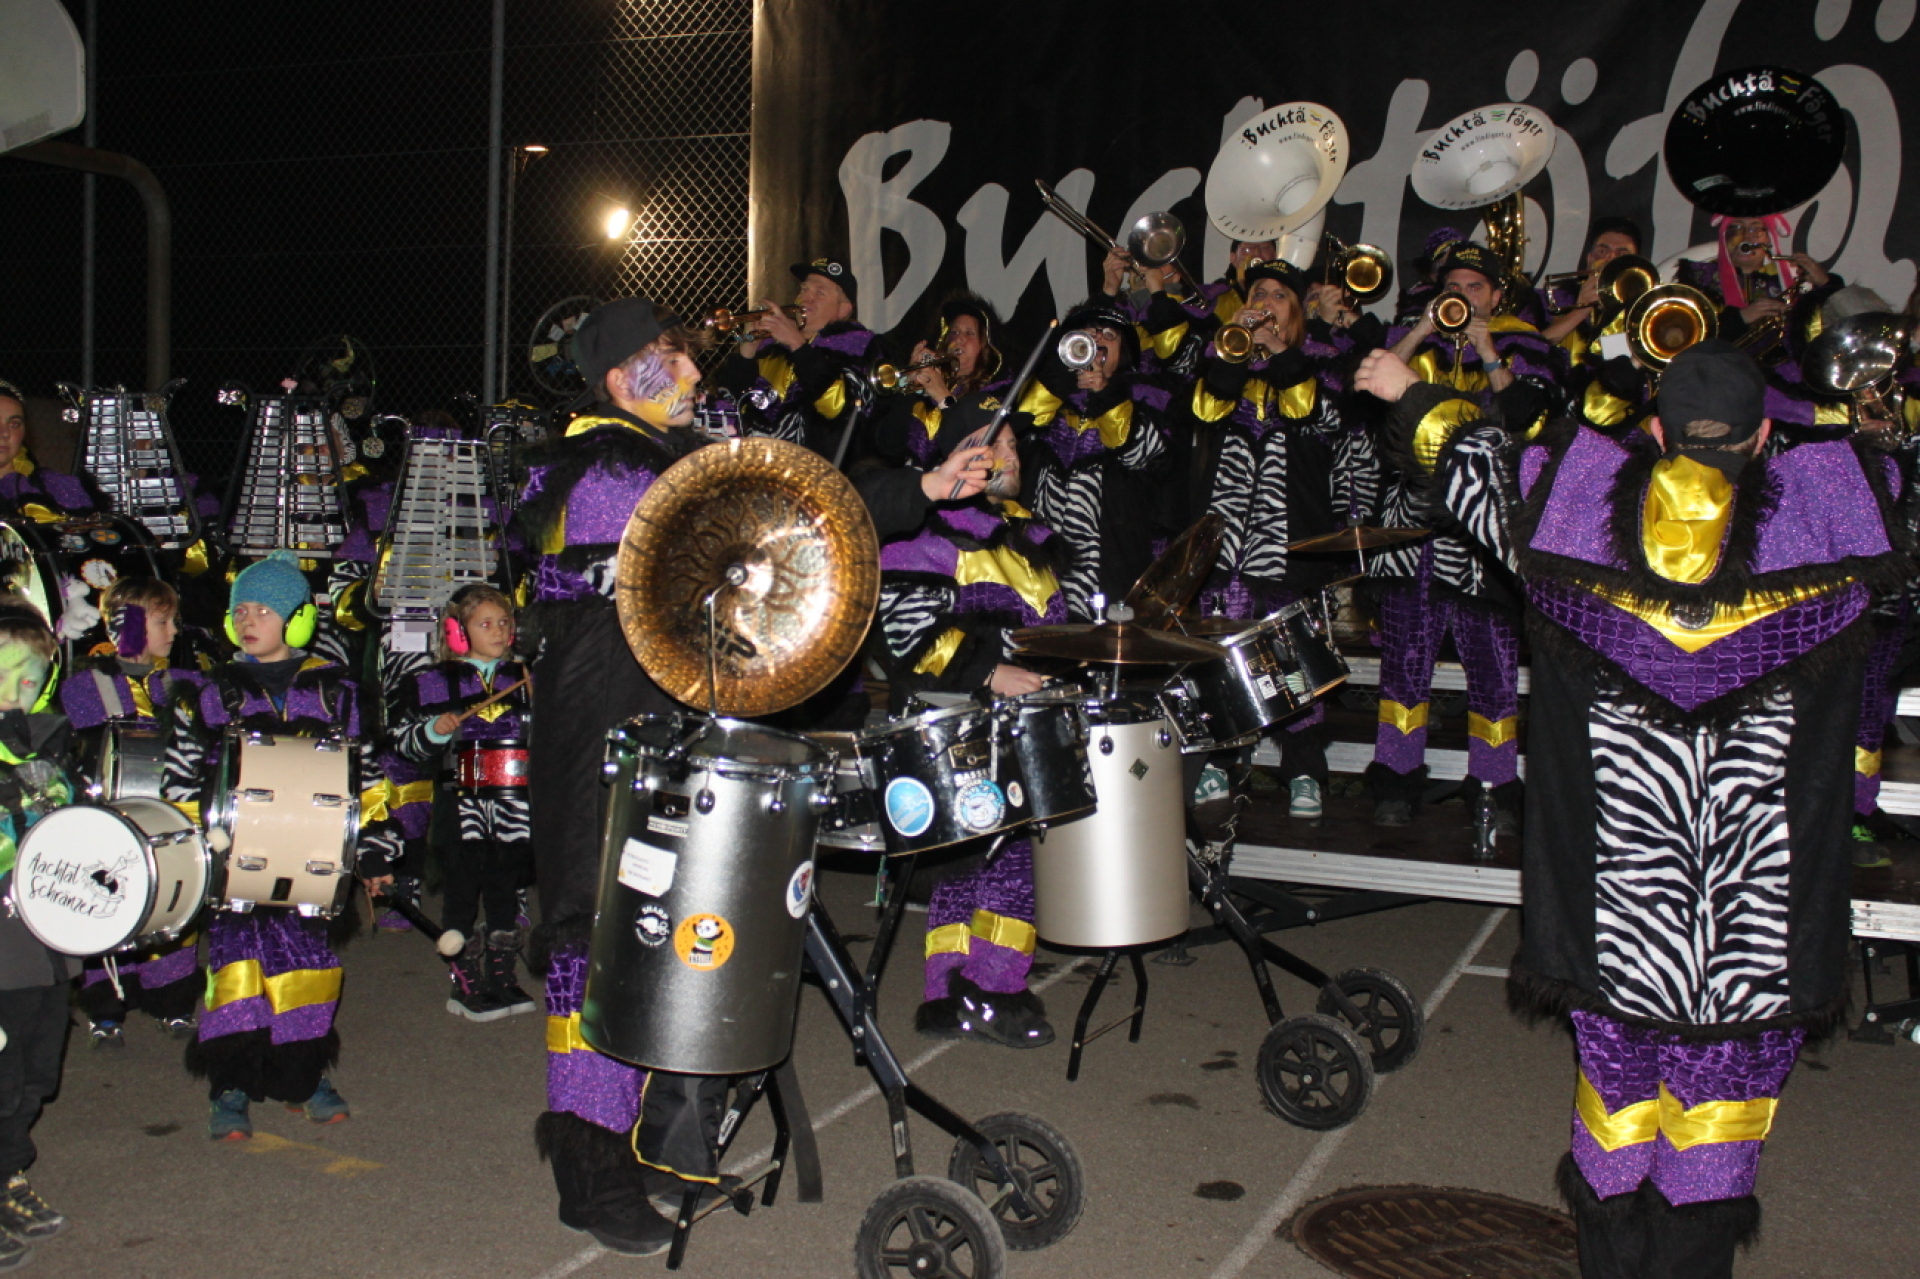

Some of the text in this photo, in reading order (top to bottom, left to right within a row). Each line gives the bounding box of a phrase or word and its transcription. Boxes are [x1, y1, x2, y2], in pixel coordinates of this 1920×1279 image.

[1242, 106, 1306, 145] Buchtä
[1685, 69, 1833, 144] Buchtä Fäger
[1422, 107, 1544, 161] Buchtä Fäger
